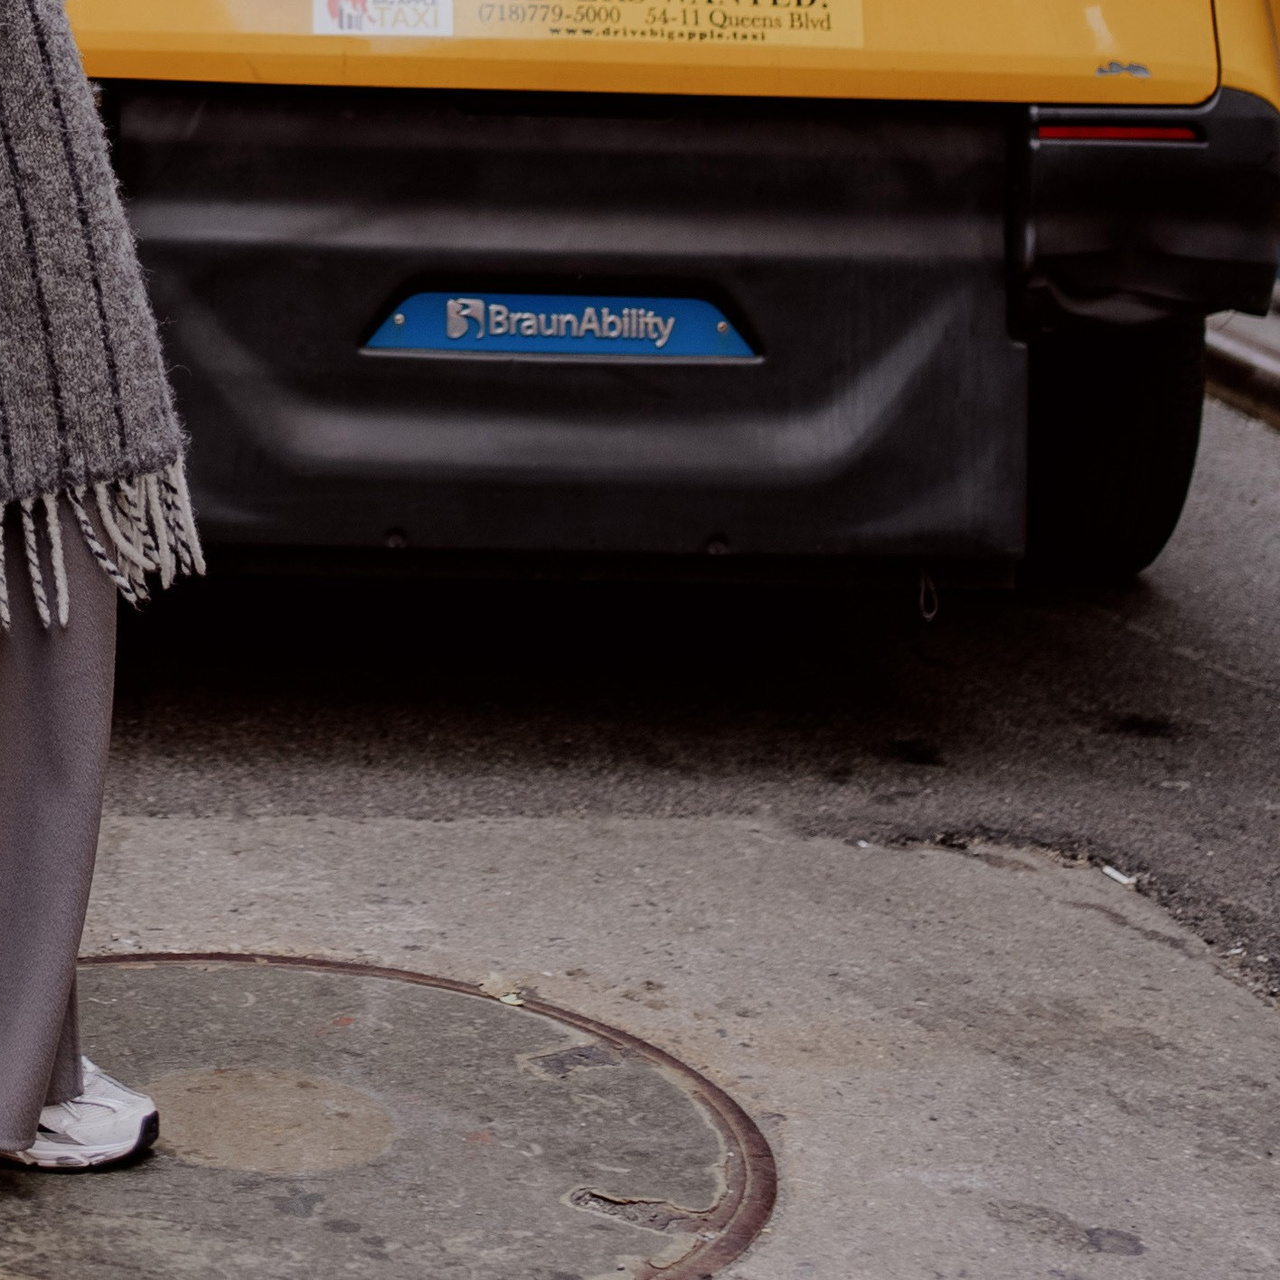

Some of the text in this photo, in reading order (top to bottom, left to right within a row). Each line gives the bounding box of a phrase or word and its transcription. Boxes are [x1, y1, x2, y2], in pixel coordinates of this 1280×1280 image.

[374, 6, 439, 29] TAXI
[477, 4, 832, 32] (718)779-5000 54-11 Queens Blvd
[488, 304, 676, 348] BraunAbility
